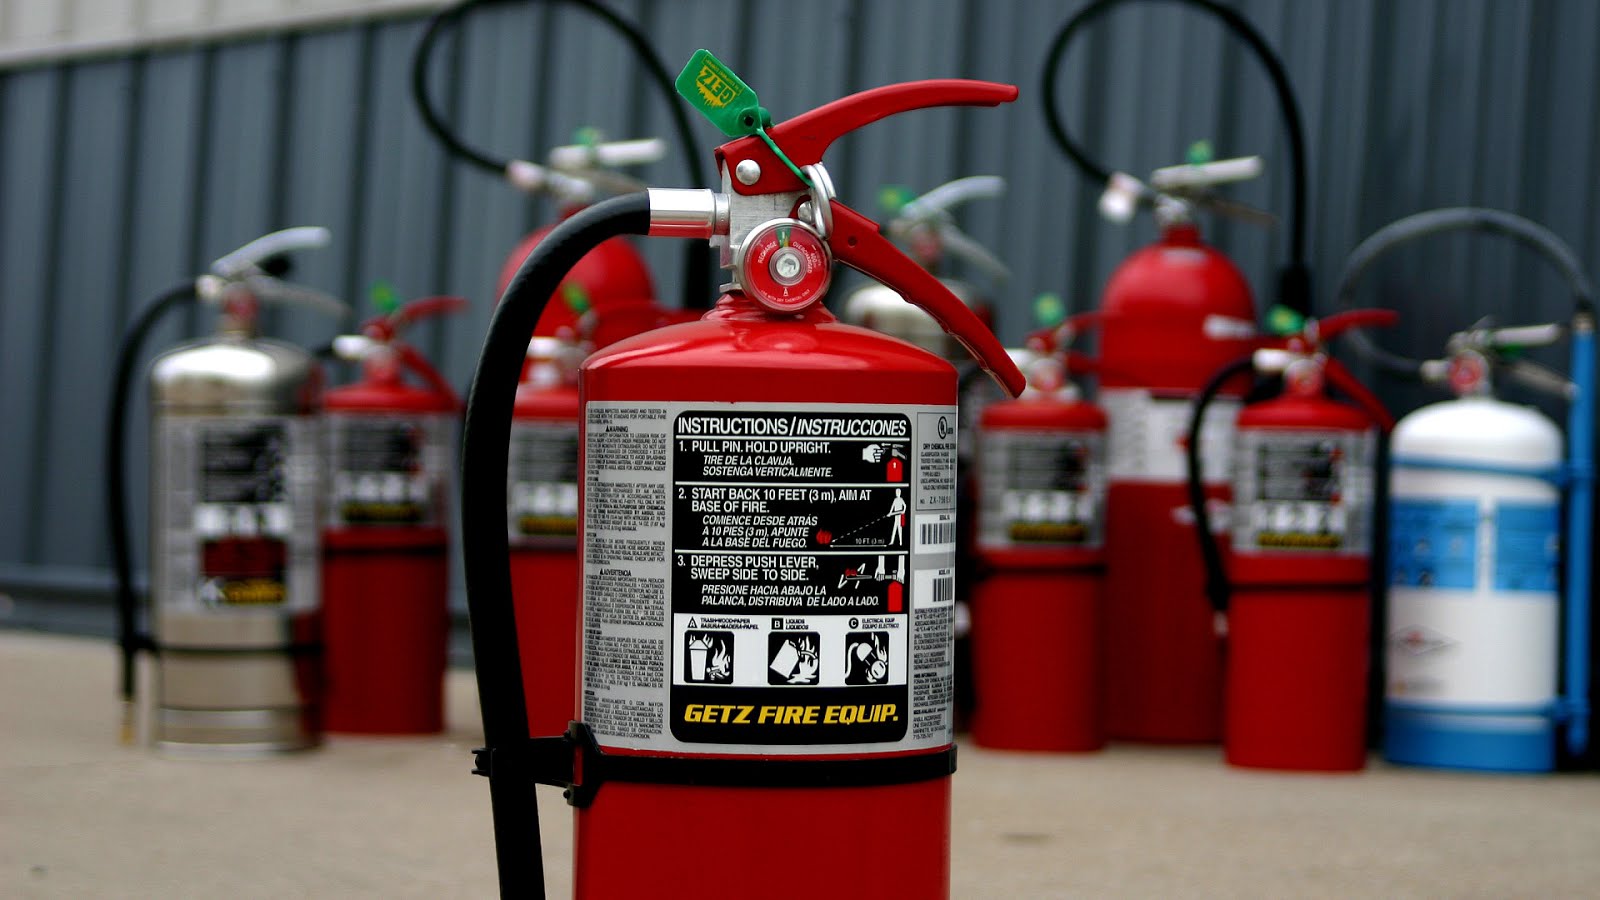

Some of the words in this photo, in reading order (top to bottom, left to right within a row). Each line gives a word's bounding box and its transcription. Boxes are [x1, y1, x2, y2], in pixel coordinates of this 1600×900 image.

[698, 68, 734, 104] GETZ
[758, 241, 777, 264] RECHARGE
[792, 241, 812, 273] OVERCHARGED
[679, 441, 687, 452] 1.
[692, 442, 720, 452] PULL
[722, 442, 743, 452] PIN.
[745, 442, 778, 453] HOLD
[780, 443, 831, 453] UPRIGHT.
[703, 455, 722, 465] TIRE
[724, 456, 737, 465] DE
[739, 456, 751, 465] LA
[754, 456, 794, 466] CLAVIJA.
[703, 467, 751, 476] SOSTENGA
[752, 467, 833, 477] VERTICALMENTE.
[679, 489, 686, 498] 2.
[692, 489, 726, 500] START
[729, 489, 760, 500] BACK
[764, 490, 775, 500] 10
[778, 490, 806, 500] FEET
[809, 490, 819, 502] (3
[821, 490, 836, 503] m),
[839, 490, 857, 500] AIM
[859, 490, 871, 500] AT
[692, 501, 720, 512] BASE
[724, 501, 739, 512] OF
[742, 501, 770, 513] FIRE.
[703, 515, 751, 525] COMIENCE
[753, 516, 785, 526] DESDE
[787, 514, 818, 526] ATRÁS
[702, 526, 709, 535] A
[712, 526, 721, 535] 10
[723, 527, 744, 536] PIES
[745, 527, 754, 538] (3
[771, 527, 809, 536] APUNTE
[702, 537, 709, 546] A
[711, 538, 722, 546] LA
[725, 538, 750, 547] BASE
[752, 538, 770, 547] DEL
[772, 538, 807, 548] FUEGO.
[678, 555, 686, 566] 3.
[691, 556, 742, 568] DEPRESS
[746, 556, 776, 568] PUSH
[780, 556, 819, 569] LEVER,
[691, 568, 730, 579] SWEEP
[732, 569, 758, 580] SIDE
[762, 569, 778, 580] TO
[780, 570, 809, 580] SIDE.
[702, 585, 749, 595] PRESIONE
[750, 585, 779, 595] HACIA
[781, 586, 812, 596] ABAJO
[814, 586, 826, 596] LA
[702, 595, 746, 607] PALANCA,
[749, 596, 802, 606] DISTRIBUYA
[807, 597, 819, 606] DE
[821, 597, 846, 606] LADO
[847, 597, 855, 606] A
[855, 597, 879, 606] LADO.
[684, 704, 754, 723] GETZ
[758, 704, 821, 724] FIRE
[823, 704, 899, 725] EQUIP.
